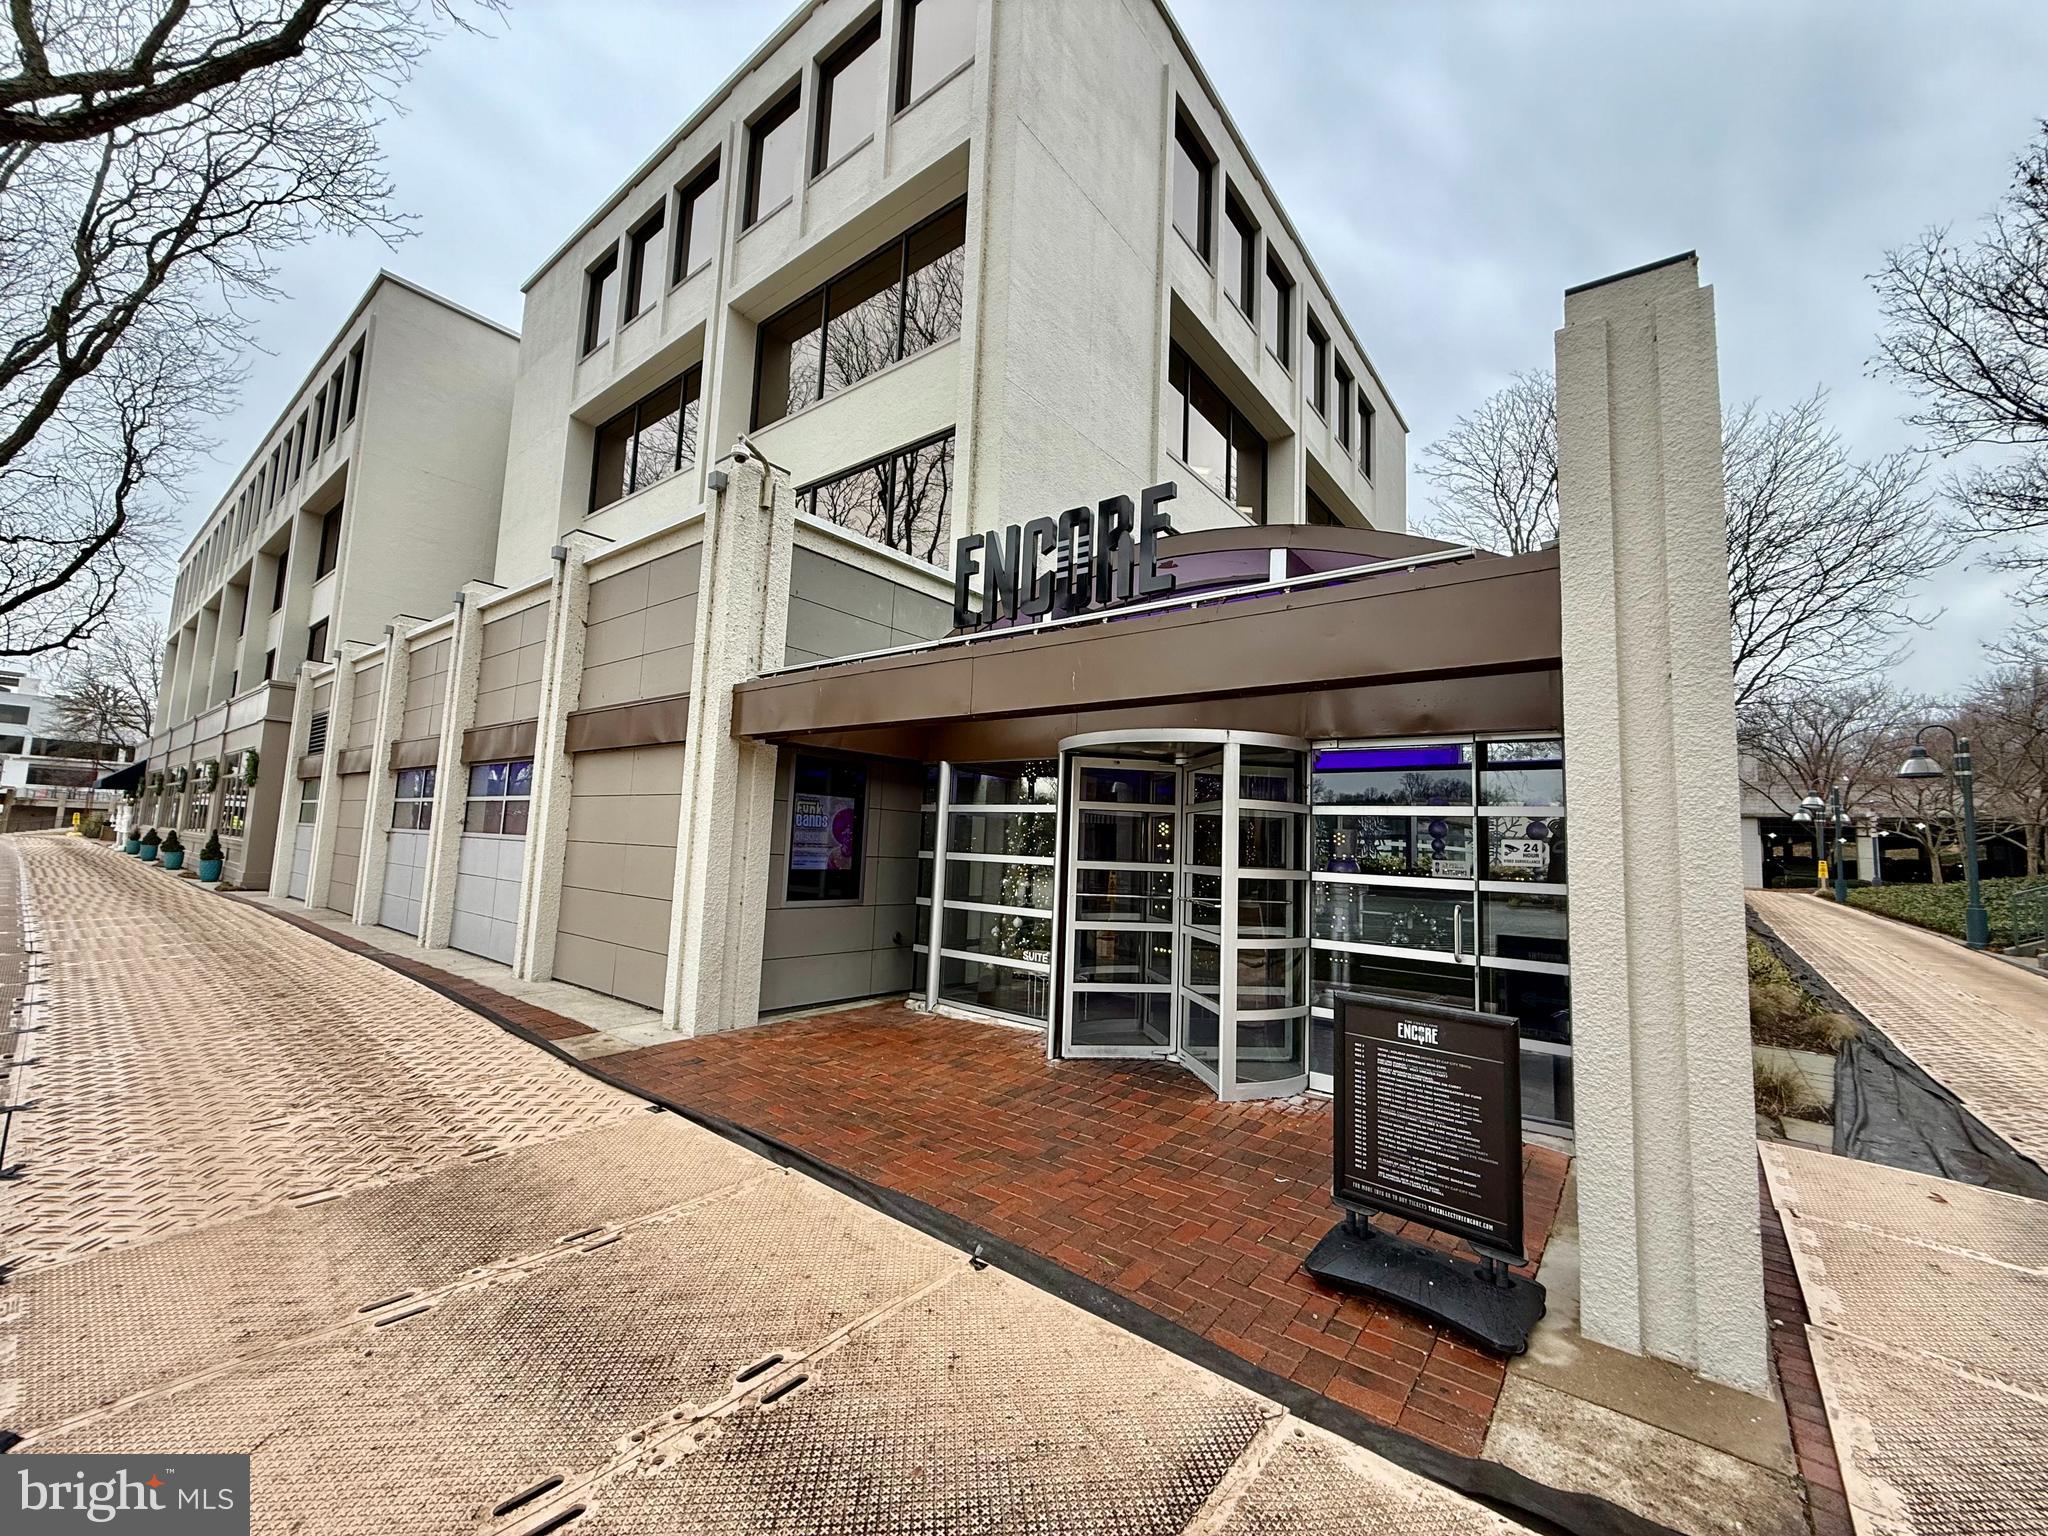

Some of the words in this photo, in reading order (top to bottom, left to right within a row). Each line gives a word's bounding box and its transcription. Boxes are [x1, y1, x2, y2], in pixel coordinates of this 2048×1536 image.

[953, 481, 1177, 628] ENCORE
[1523, 843, 1539, 853] 24
[1022, 950, 1050, 963] SUITE
[1397, 1022, 1439, 1046] ENCORE
